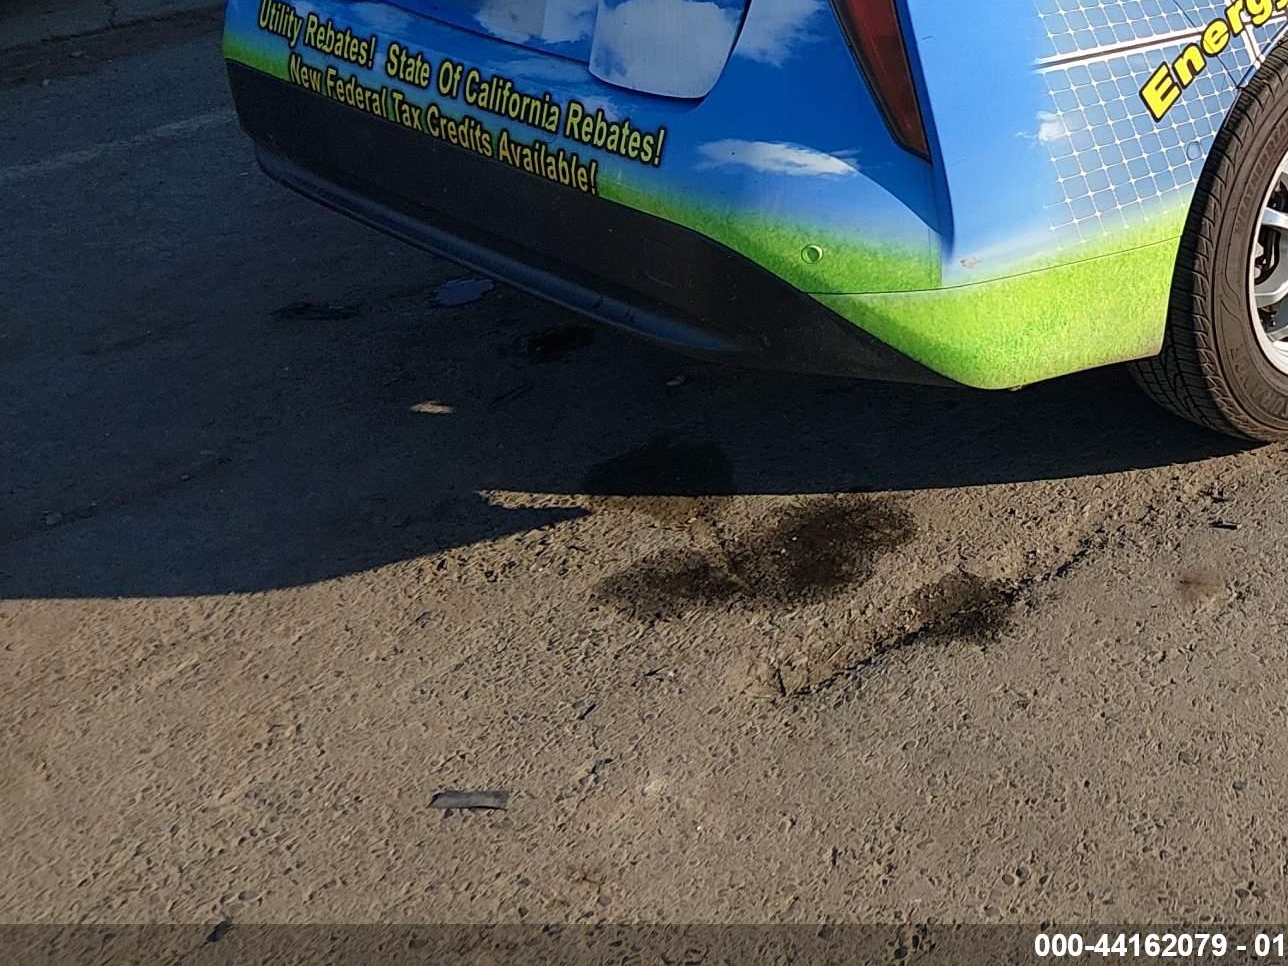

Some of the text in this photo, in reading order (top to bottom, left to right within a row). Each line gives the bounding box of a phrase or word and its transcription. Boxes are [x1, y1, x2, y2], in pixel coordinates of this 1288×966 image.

[288, 53, 598, 196] New Federal Tax Credits Available!
[304, 13, 377, 68] Rebates!
[386, 43, 431, 89] State
[437, 60, 462, 99] Of
[464, 70, 561, 132] California
[565, 101, 666, 166] Rebates!
